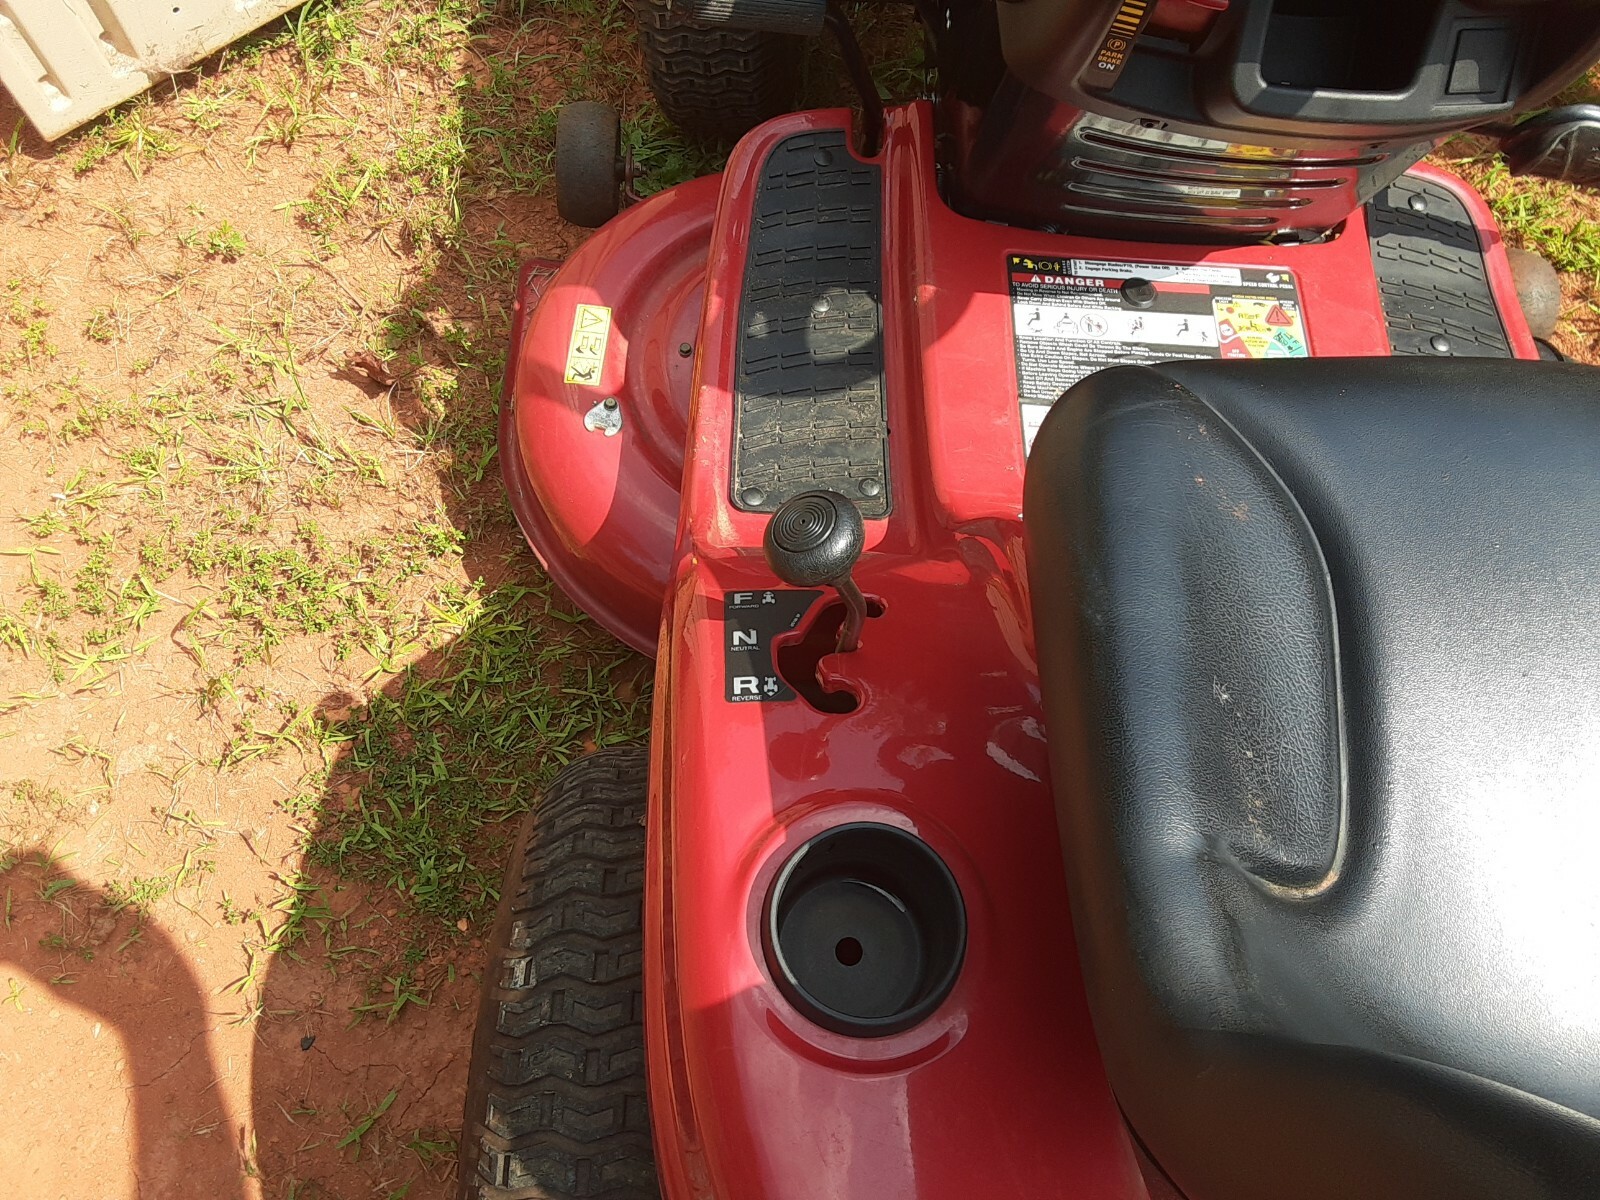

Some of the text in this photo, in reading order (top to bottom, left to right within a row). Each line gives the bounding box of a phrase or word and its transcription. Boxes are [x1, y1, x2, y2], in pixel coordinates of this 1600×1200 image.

[1098, 55, 1122, 65] BRAKE
[1100, 50, 1124, 59] PARK
[1098, 62, 1115, 70] ON
[1044, 275, 1104, 287] DANGER
[734, 592, 753, 604] F
[733, 629, 757, 645] N
[733, 676, 759, 695] R
